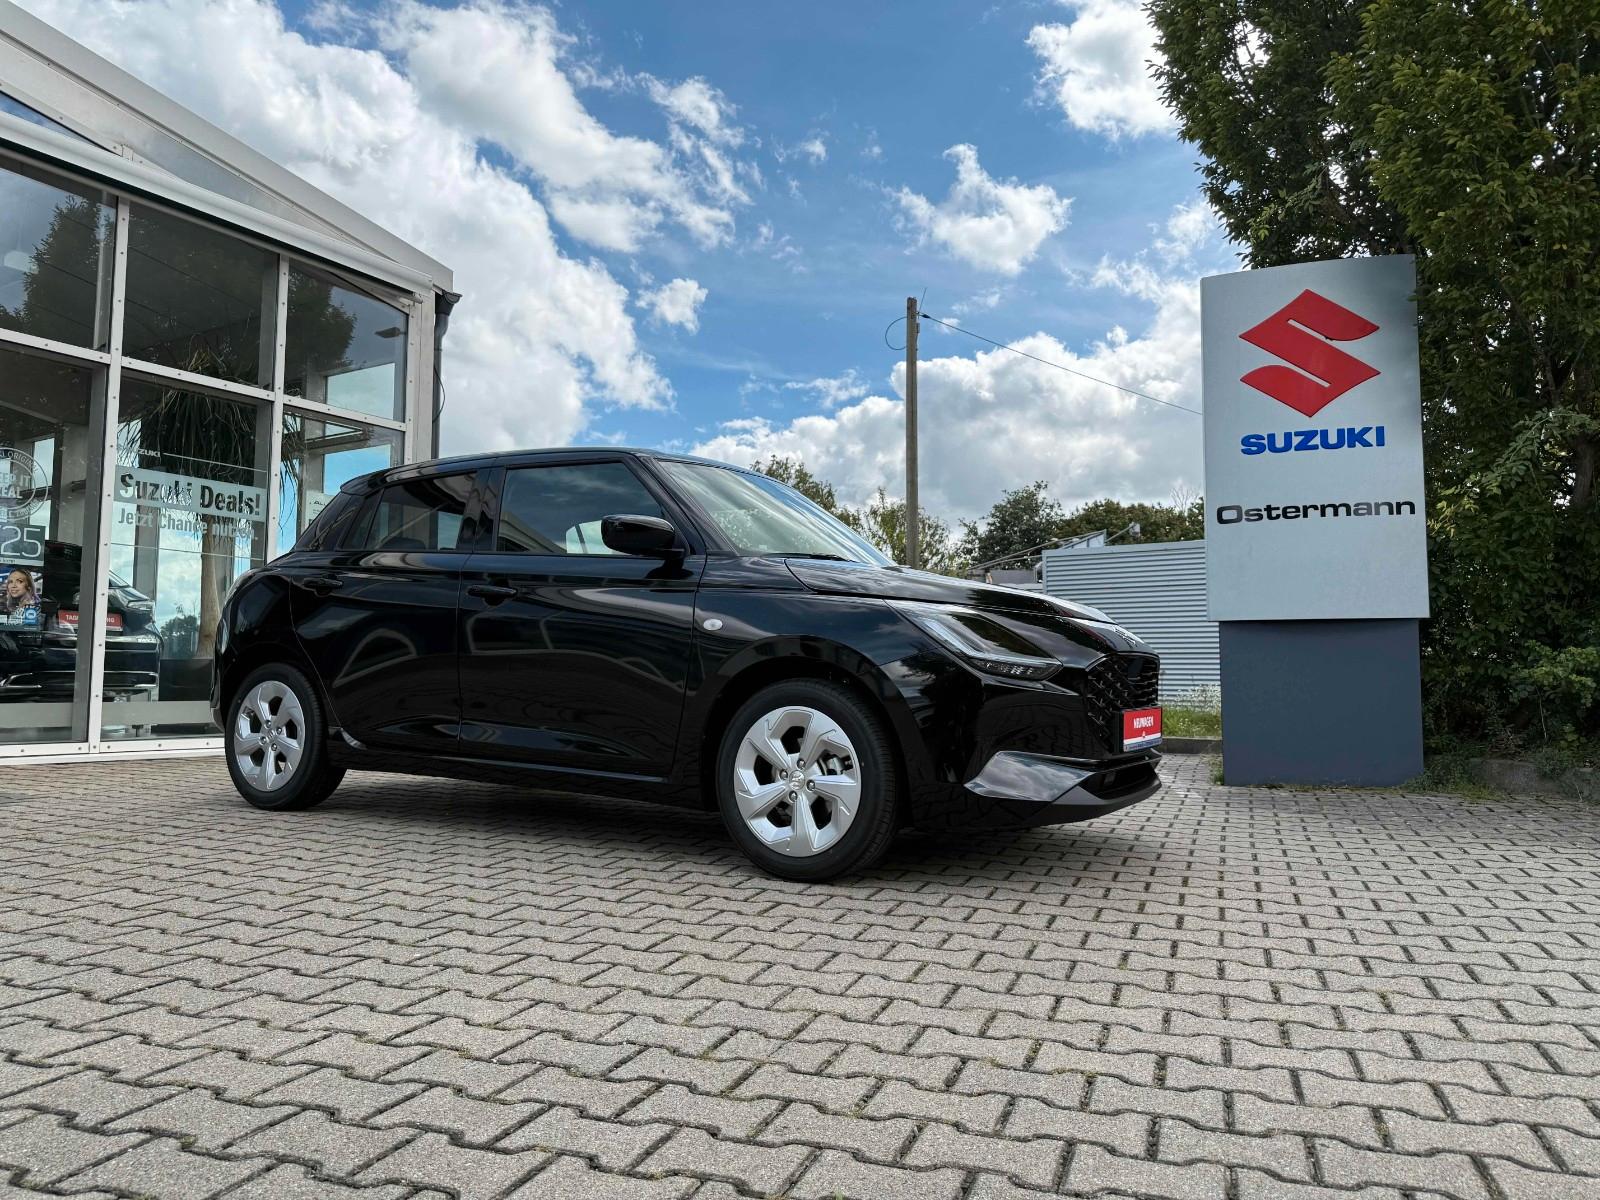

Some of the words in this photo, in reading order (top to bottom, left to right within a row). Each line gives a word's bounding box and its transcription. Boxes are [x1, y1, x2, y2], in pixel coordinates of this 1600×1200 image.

[1240, 425, 1386, 456] SUZUKI
[119, 472, 193, 506] Suzuki
[199, 484, 261, 516] Deals!
[118, 507, 154, 528] Jetzt
[159, 513, 208, 534] Chance
[1216, 500, 1416, 525] Ostermann
